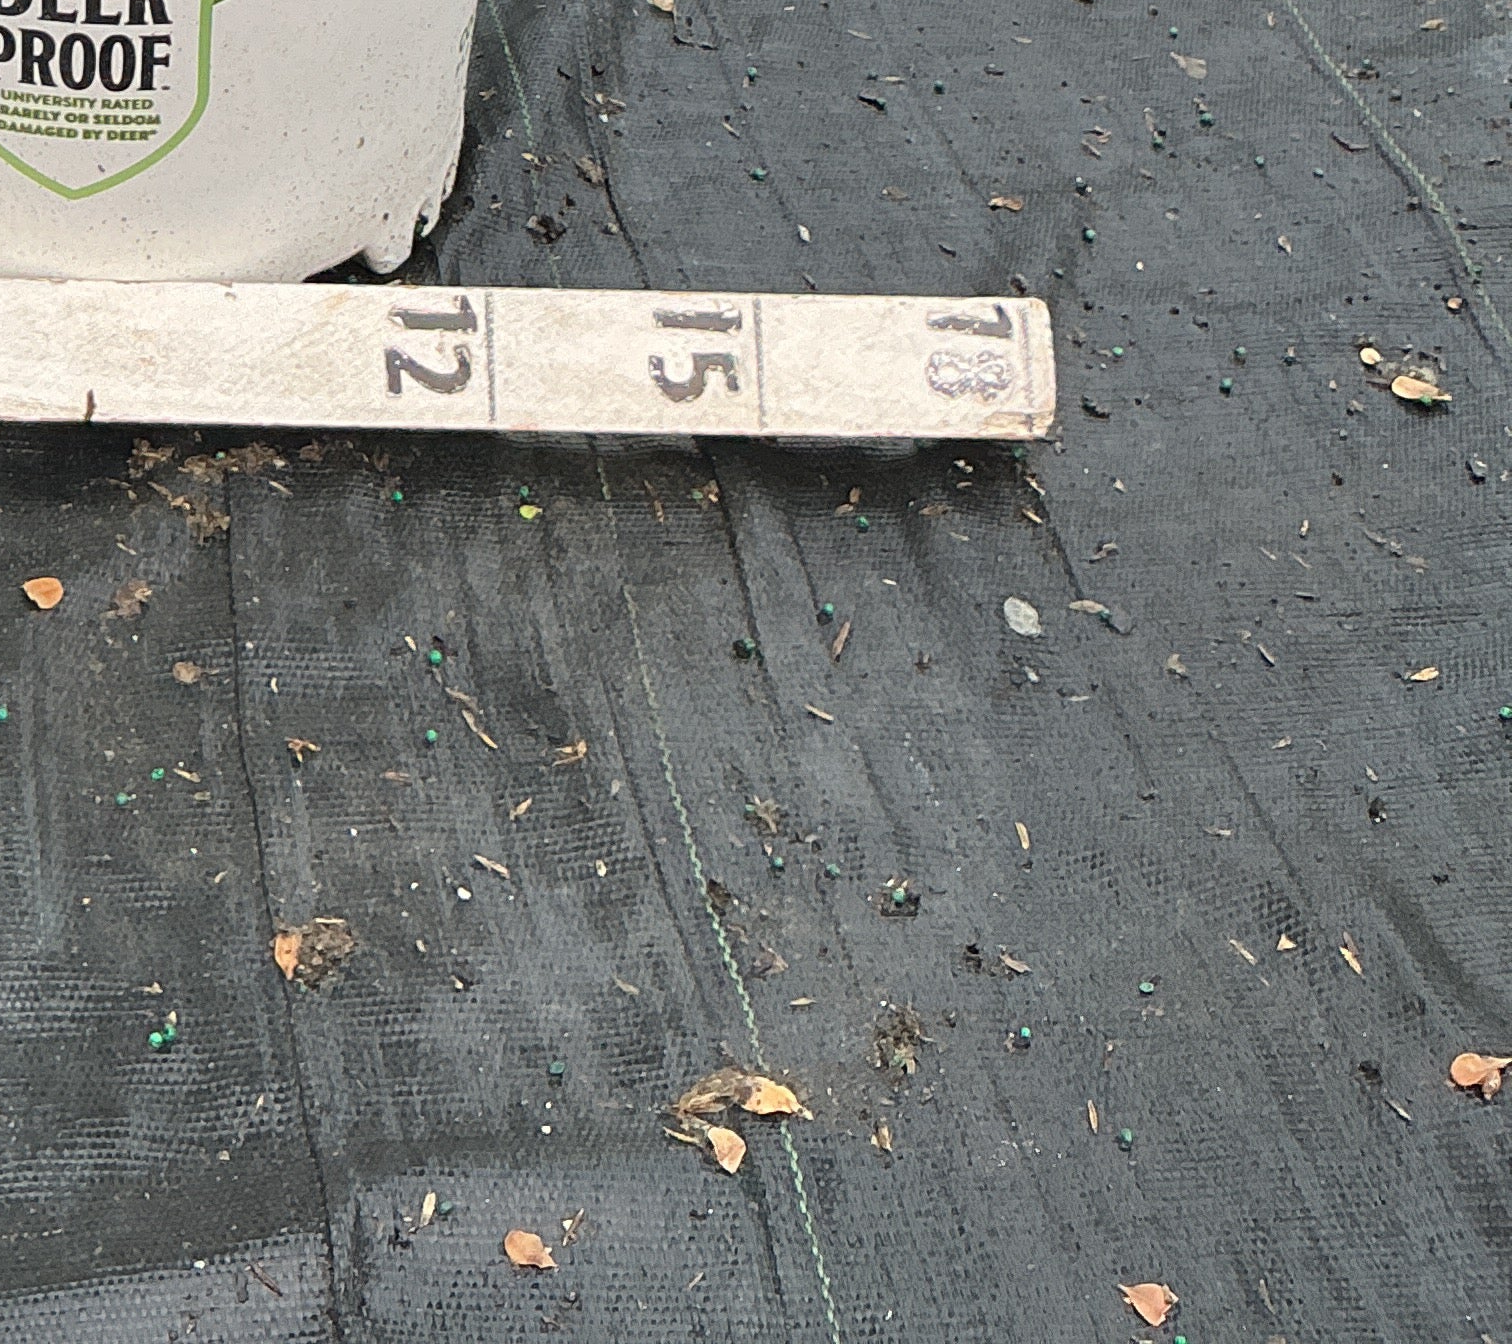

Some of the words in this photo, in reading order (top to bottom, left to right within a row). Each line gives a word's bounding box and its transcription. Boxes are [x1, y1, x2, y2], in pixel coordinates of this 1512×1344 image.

[0, 88, 96, 110] UNIVERSITY
[100, 98, 154, 111] RATED
[64, 112, 90, 124] OR
[93, 113, 161, 126] SELDOM
[82, 129, 103, 141] BY
[384, 295, 477, 397] 12
[648, 307, 742, 403] 15
[925, 302, 1014, 402] 18
